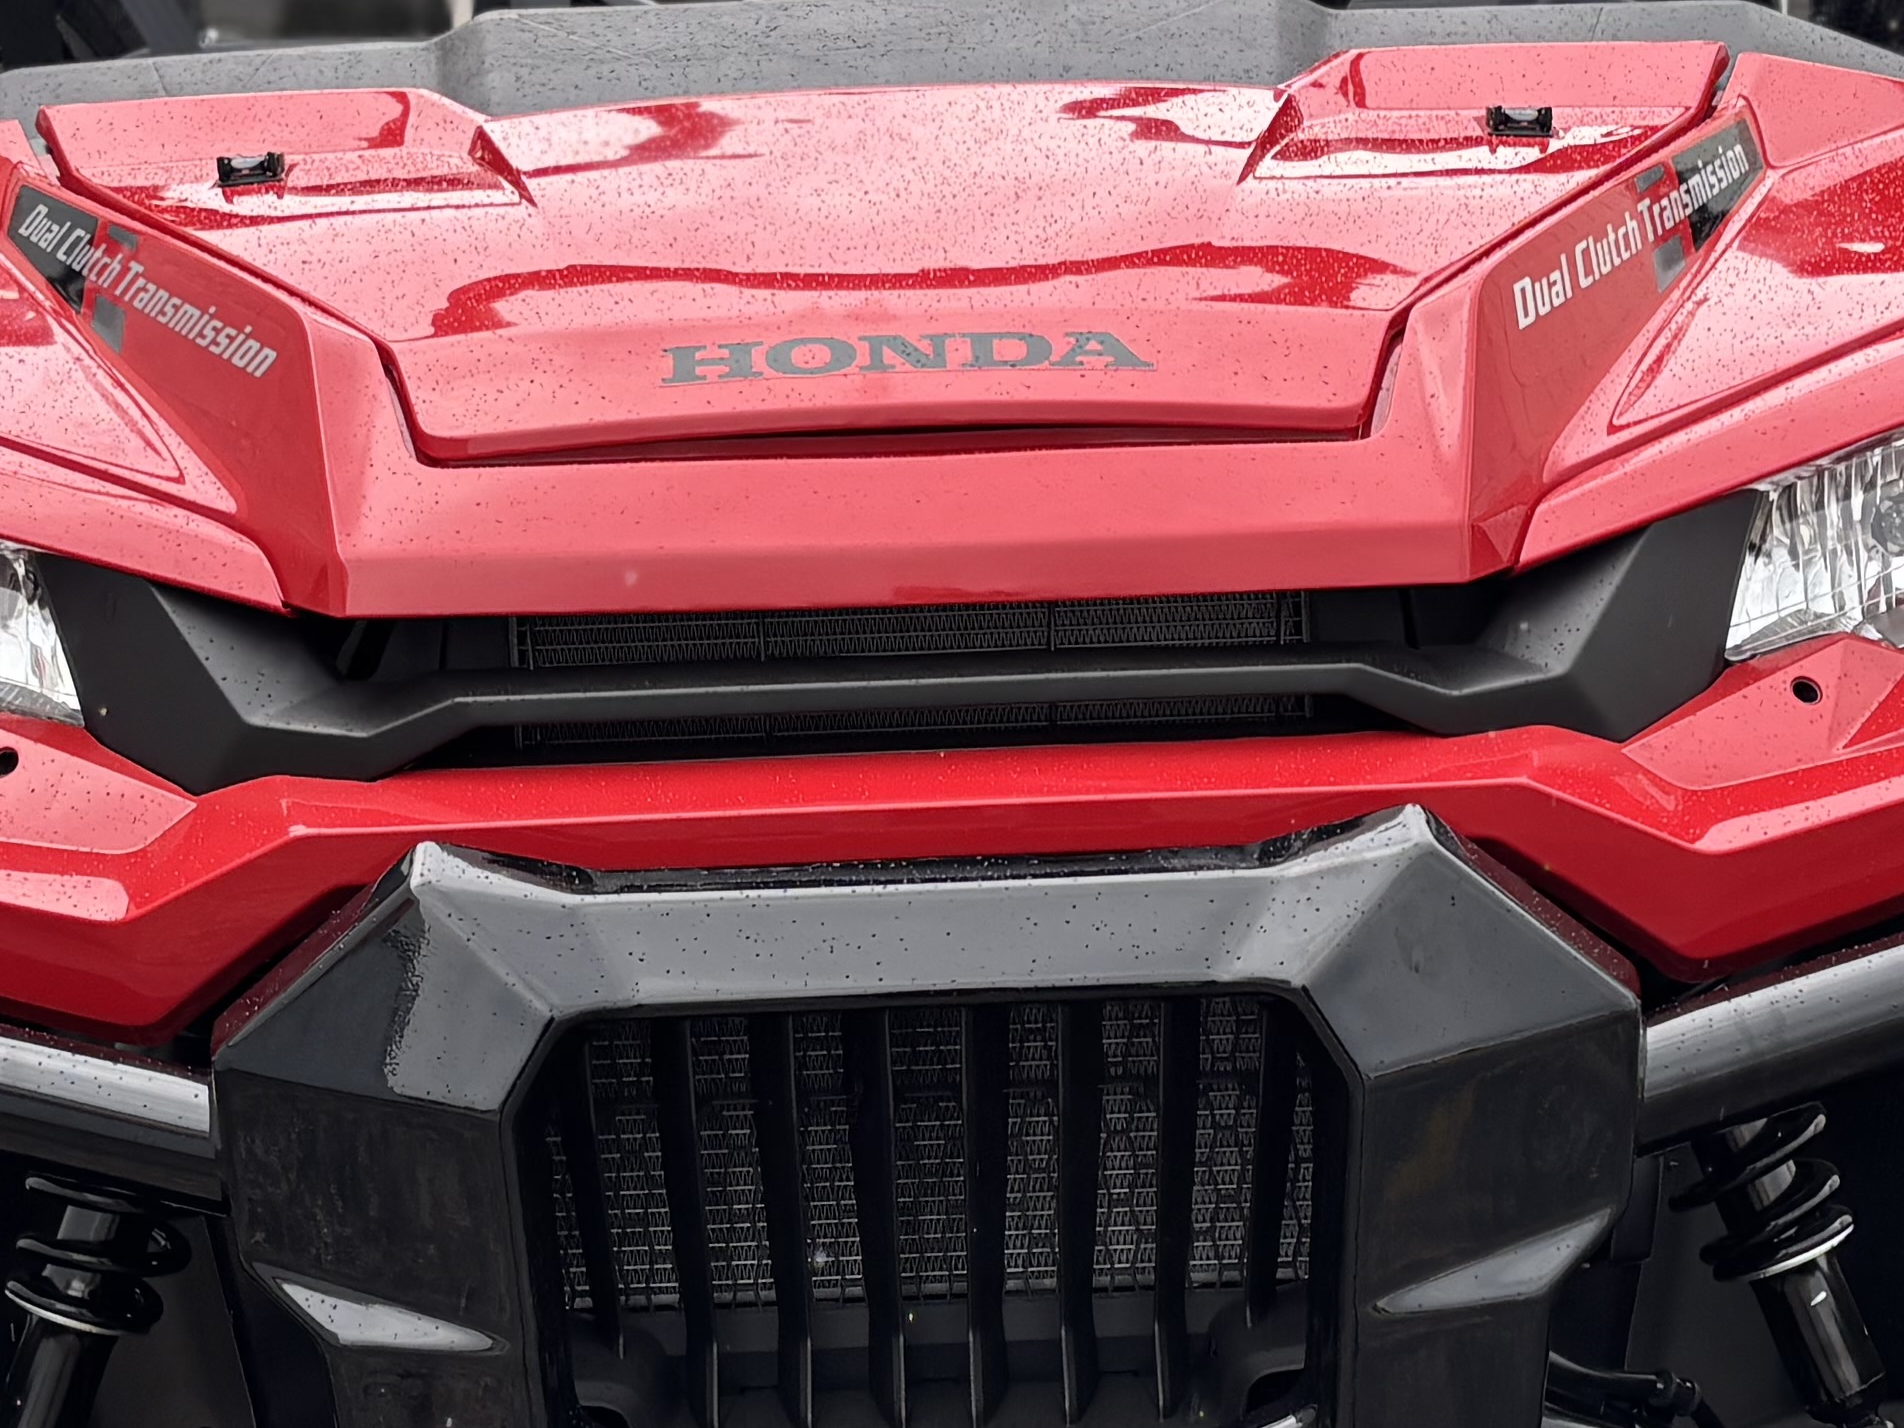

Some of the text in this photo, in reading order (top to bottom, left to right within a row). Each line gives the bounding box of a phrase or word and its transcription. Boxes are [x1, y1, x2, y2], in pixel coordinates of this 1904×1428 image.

[18, 203, 278, 378] Dual Clutch Transmission
[1512, 143, 1750, 330] Dual Clutch Transmission
[661, 331, 1158, 385] HONDA
